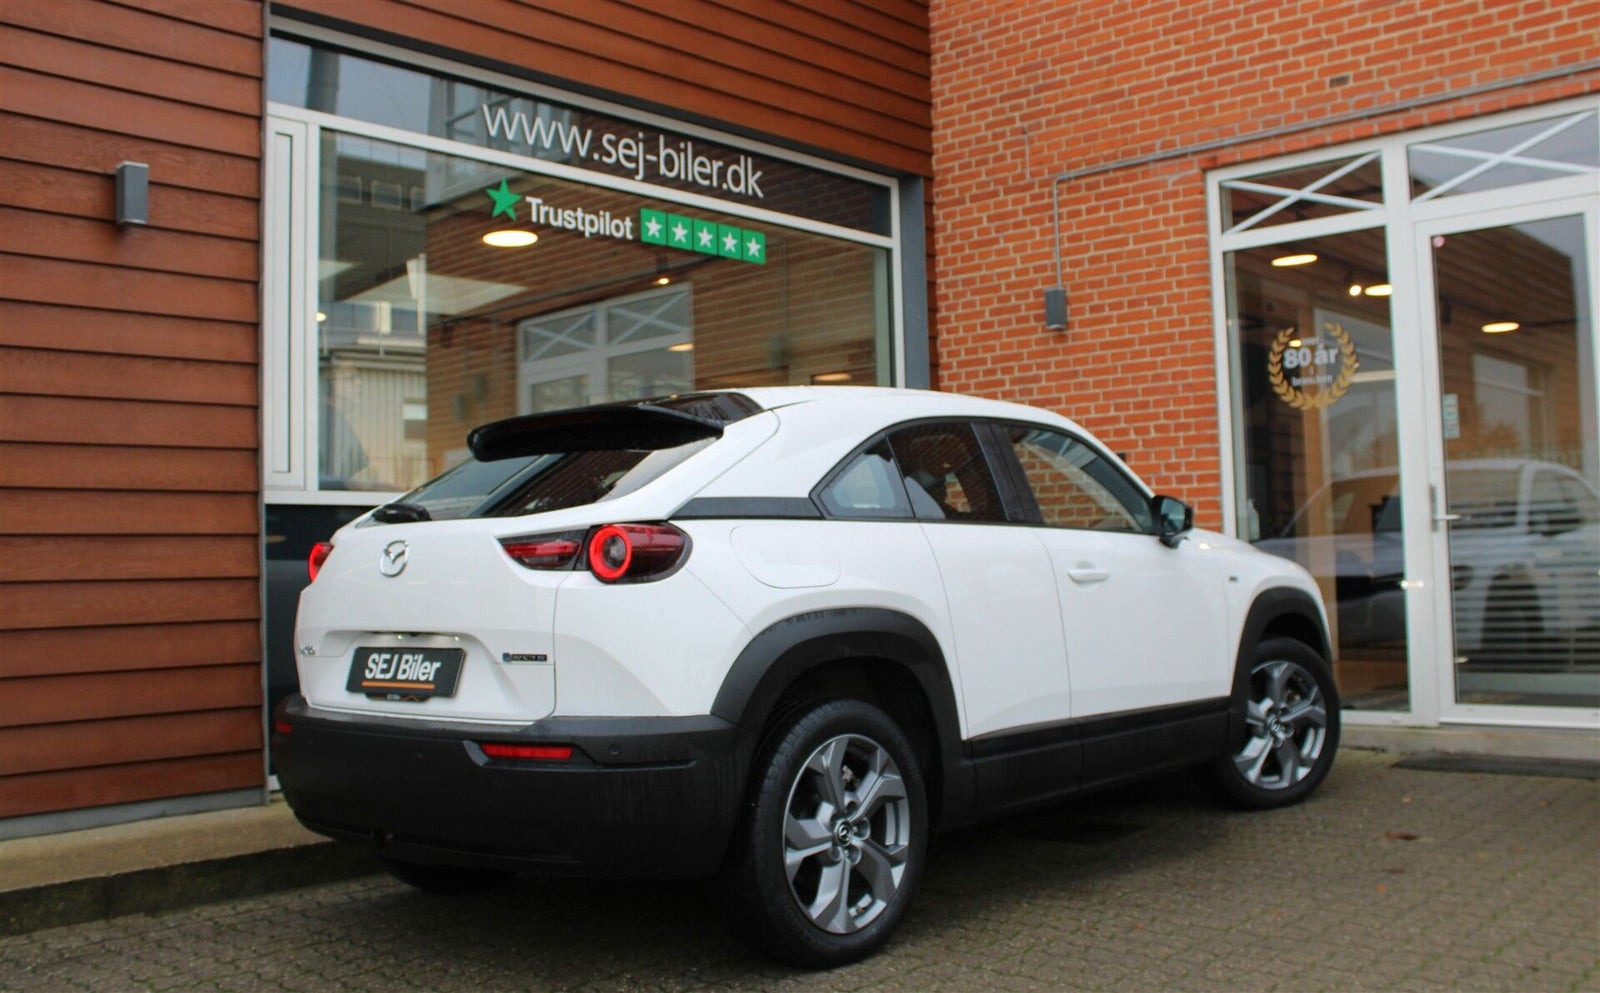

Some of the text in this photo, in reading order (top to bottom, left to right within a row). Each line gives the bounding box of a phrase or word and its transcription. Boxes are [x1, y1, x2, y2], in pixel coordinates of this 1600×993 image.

[482, 103, 764, 198] www.sej-biler.dk
[526, 196, 633, 240] Trustpilot
[1283, 347, 1312, 369] 80
[364, 653, 442, 681] SEJ Biler
